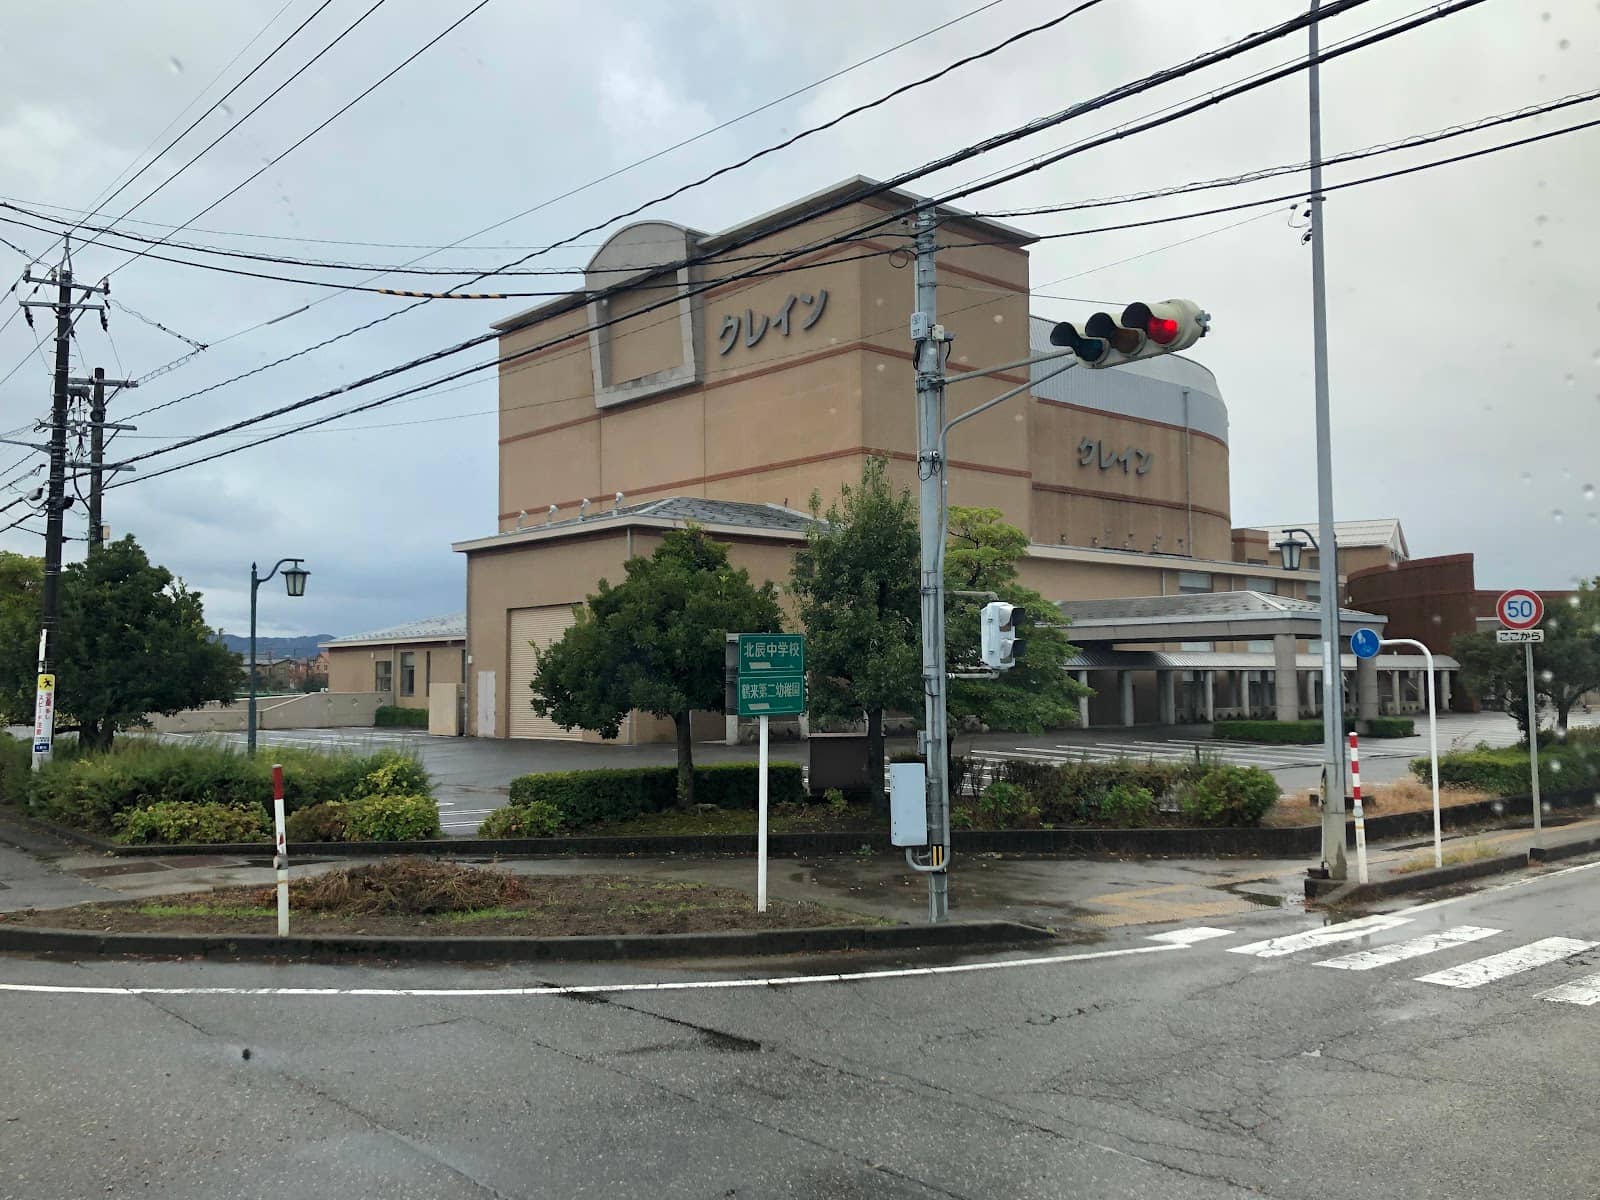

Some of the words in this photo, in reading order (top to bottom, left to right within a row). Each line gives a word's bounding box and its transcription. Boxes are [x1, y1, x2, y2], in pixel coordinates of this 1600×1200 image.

[719, 288, 828, 355] クレイン
[1078, 437, 1153, 475] クレイン
[1507, 600, 1533, 618] 50
[1499, 631, 1541, 641] ここから
[743, 641, 800, 658] 北辰中学校
